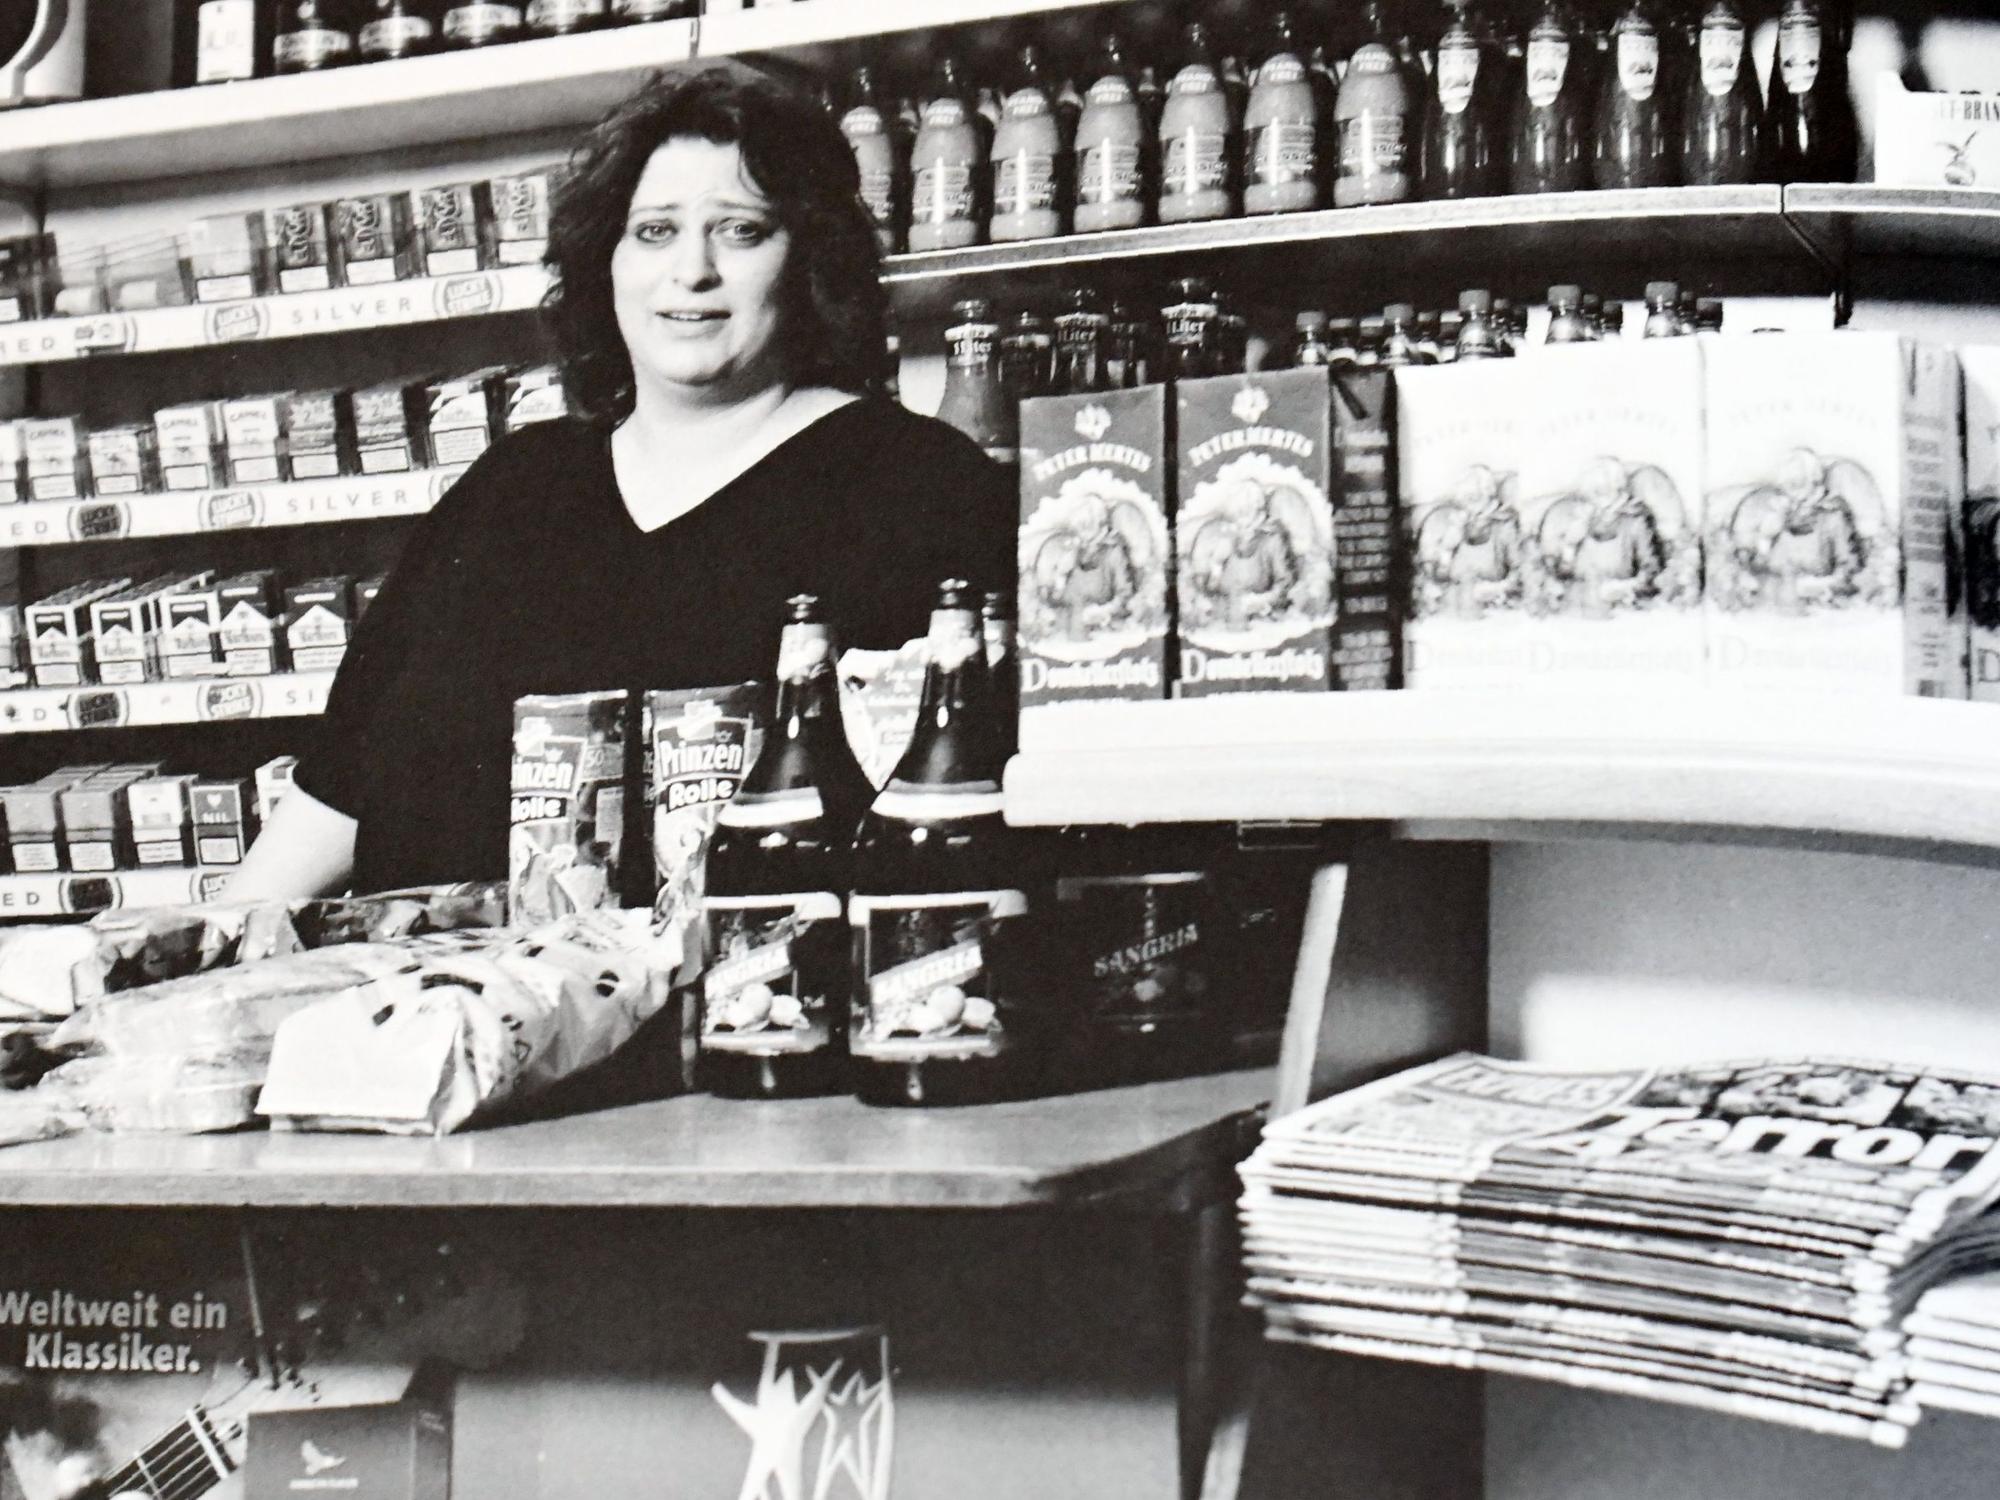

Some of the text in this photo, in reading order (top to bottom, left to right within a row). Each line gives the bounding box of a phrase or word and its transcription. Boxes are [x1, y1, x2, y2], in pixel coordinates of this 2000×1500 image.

[292, 297, 411, 325] SILVER
[287, 490, 407, 512] SILVER
[660, 740, 742, 777] Prinzen
[669, 778, 733, 810] Rolle
[1094, 923, 1198, 977] SANGRIA
[1603, 1107, 1996, 1172] Terror
[0, 1289, 226, 1329] Weltweit ein
[25, 1331, 201, 1373] Klassiker.
